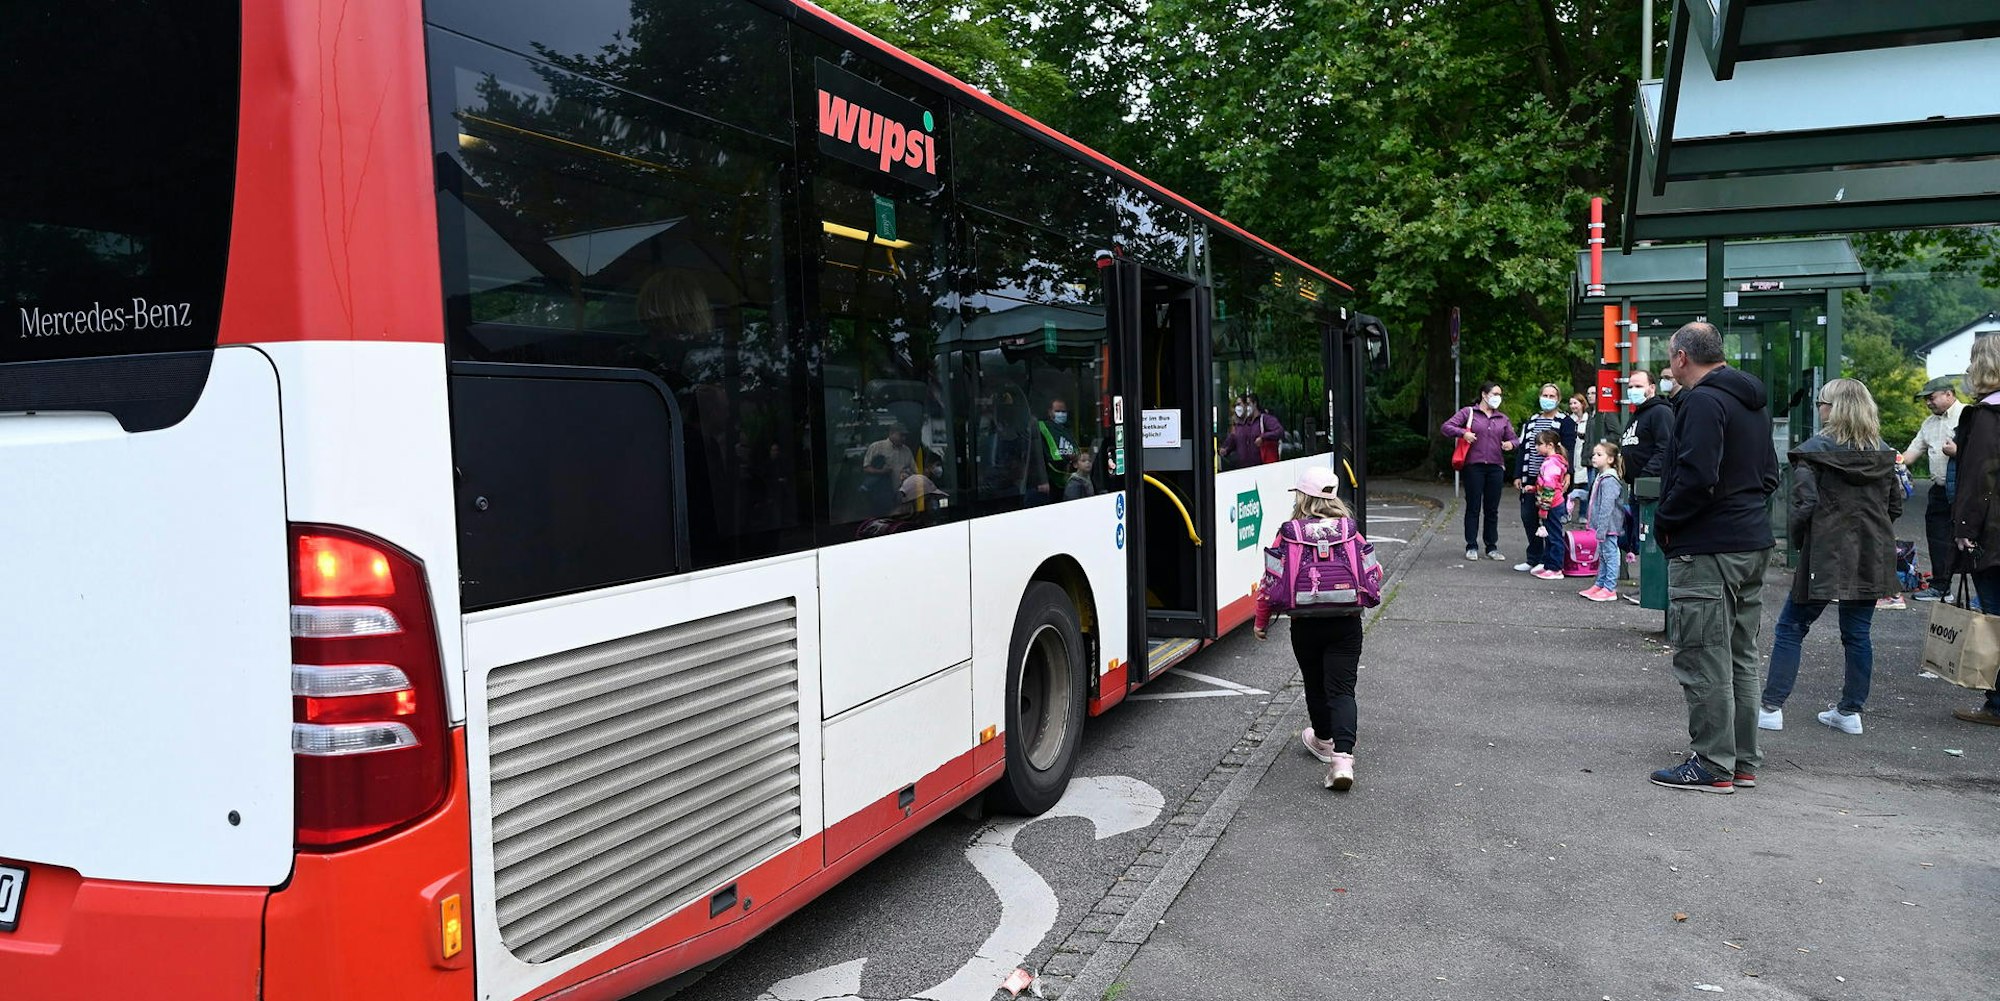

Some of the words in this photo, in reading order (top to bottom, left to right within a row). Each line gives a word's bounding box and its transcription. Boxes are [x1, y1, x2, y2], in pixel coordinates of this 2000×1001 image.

[818, 89, 936, 175] wupsi
[20, 298, 192, 338] Mercedes-Benz
[1239, 498, 1260, 520] Einstieg
[1239, 523, 1255, 541] vorne
